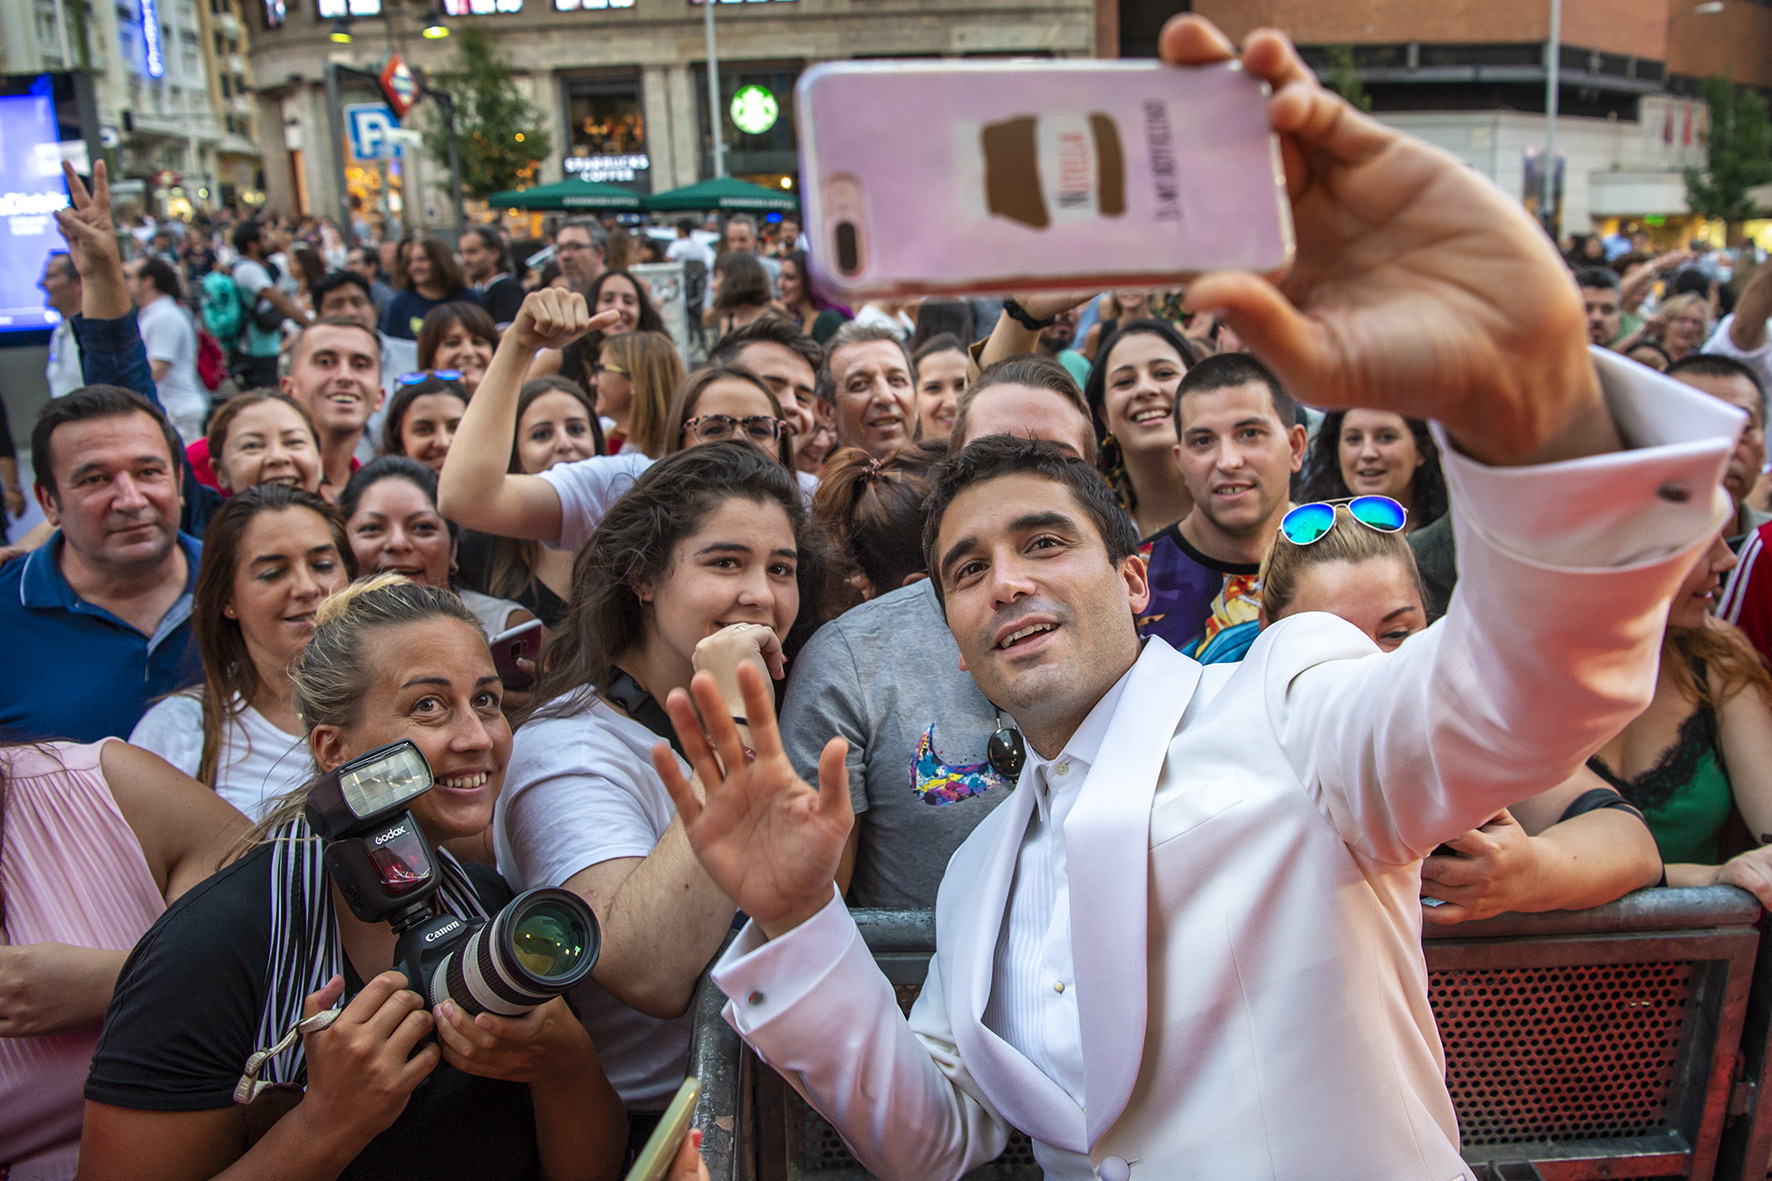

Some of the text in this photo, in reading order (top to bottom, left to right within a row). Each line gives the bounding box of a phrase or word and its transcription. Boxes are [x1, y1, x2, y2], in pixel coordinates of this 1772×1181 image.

[356, 112, 391, 154] P
[564, 154, 649, 173] STARBUCKS
[580, 168, 635, 183] COFFEE
[375, 826, 406, 845] Godox
[425, 921, 460, 942] Canon
